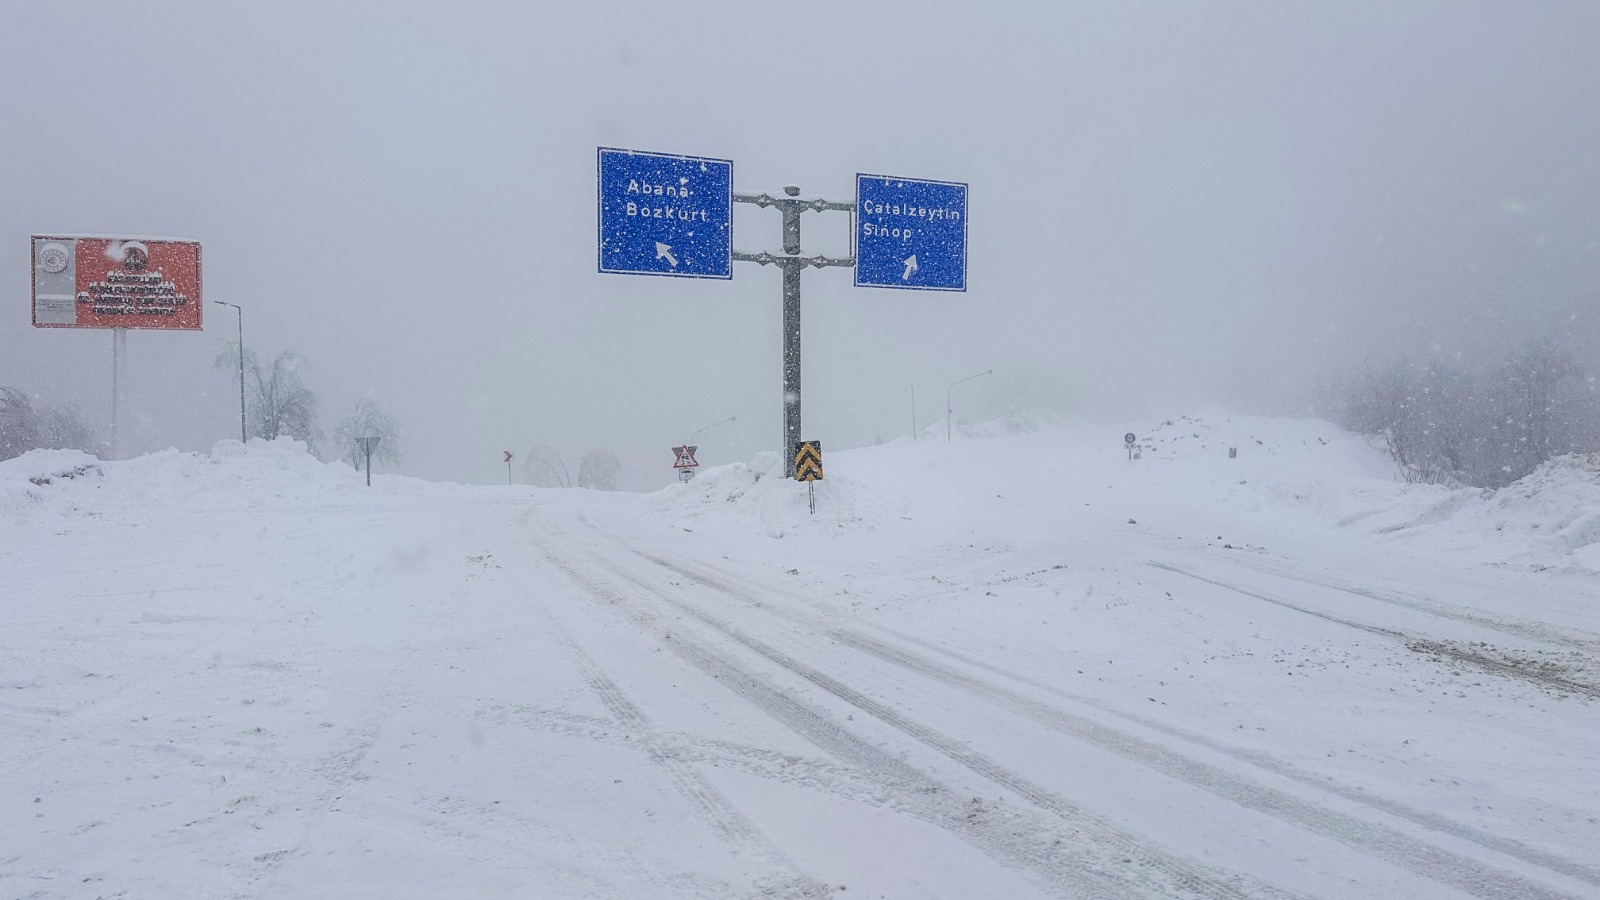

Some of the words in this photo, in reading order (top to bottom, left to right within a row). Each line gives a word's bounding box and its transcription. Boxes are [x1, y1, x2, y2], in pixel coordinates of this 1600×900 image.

[626, 179, 689, 197] Abana
[626, 202, 707, 222] Bozkurt
[864, 200, 960, 223] Çatalzeytin
[863, 223, 912, 241] Sinop
